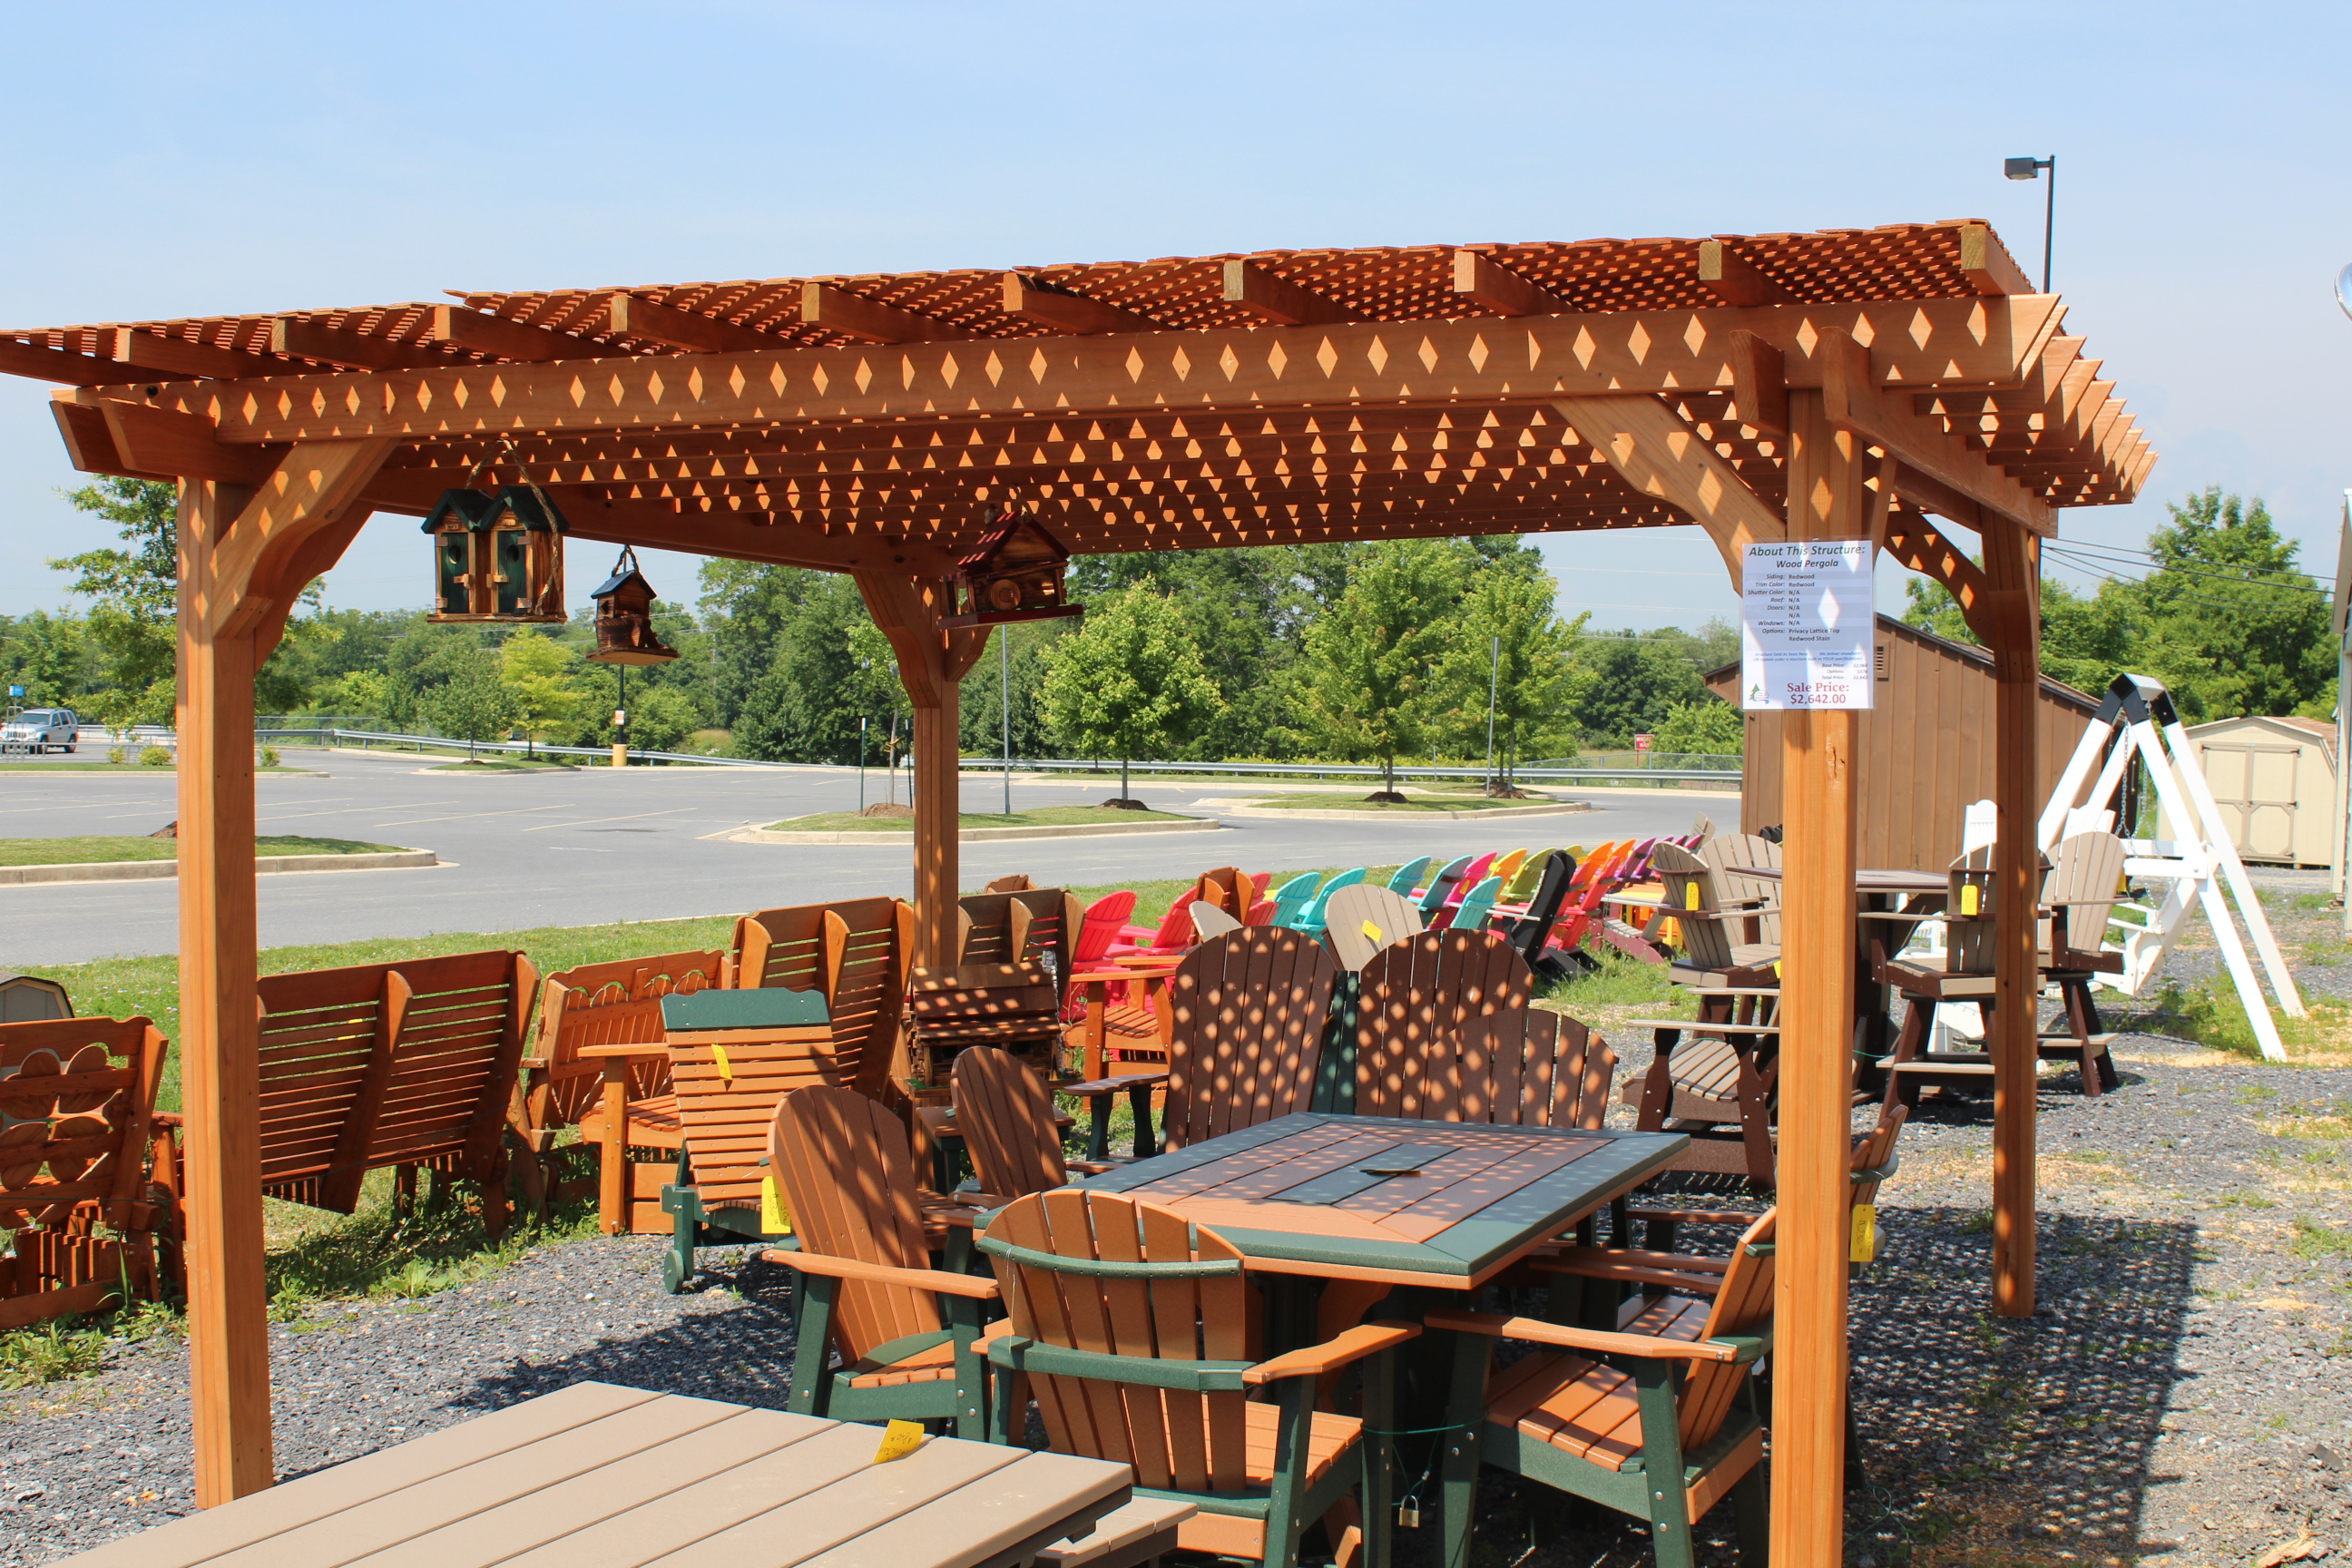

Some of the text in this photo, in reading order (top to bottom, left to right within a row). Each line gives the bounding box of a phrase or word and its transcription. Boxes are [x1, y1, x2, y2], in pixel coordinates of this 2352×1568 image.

[1749, 545, 1866, 556] About This Structure:
[1805, 560, 1838, 569] Pergola
[1787, 682, 1849, 692] Sale Price:
[1790, 694, 1846, 705] $2,642.00
